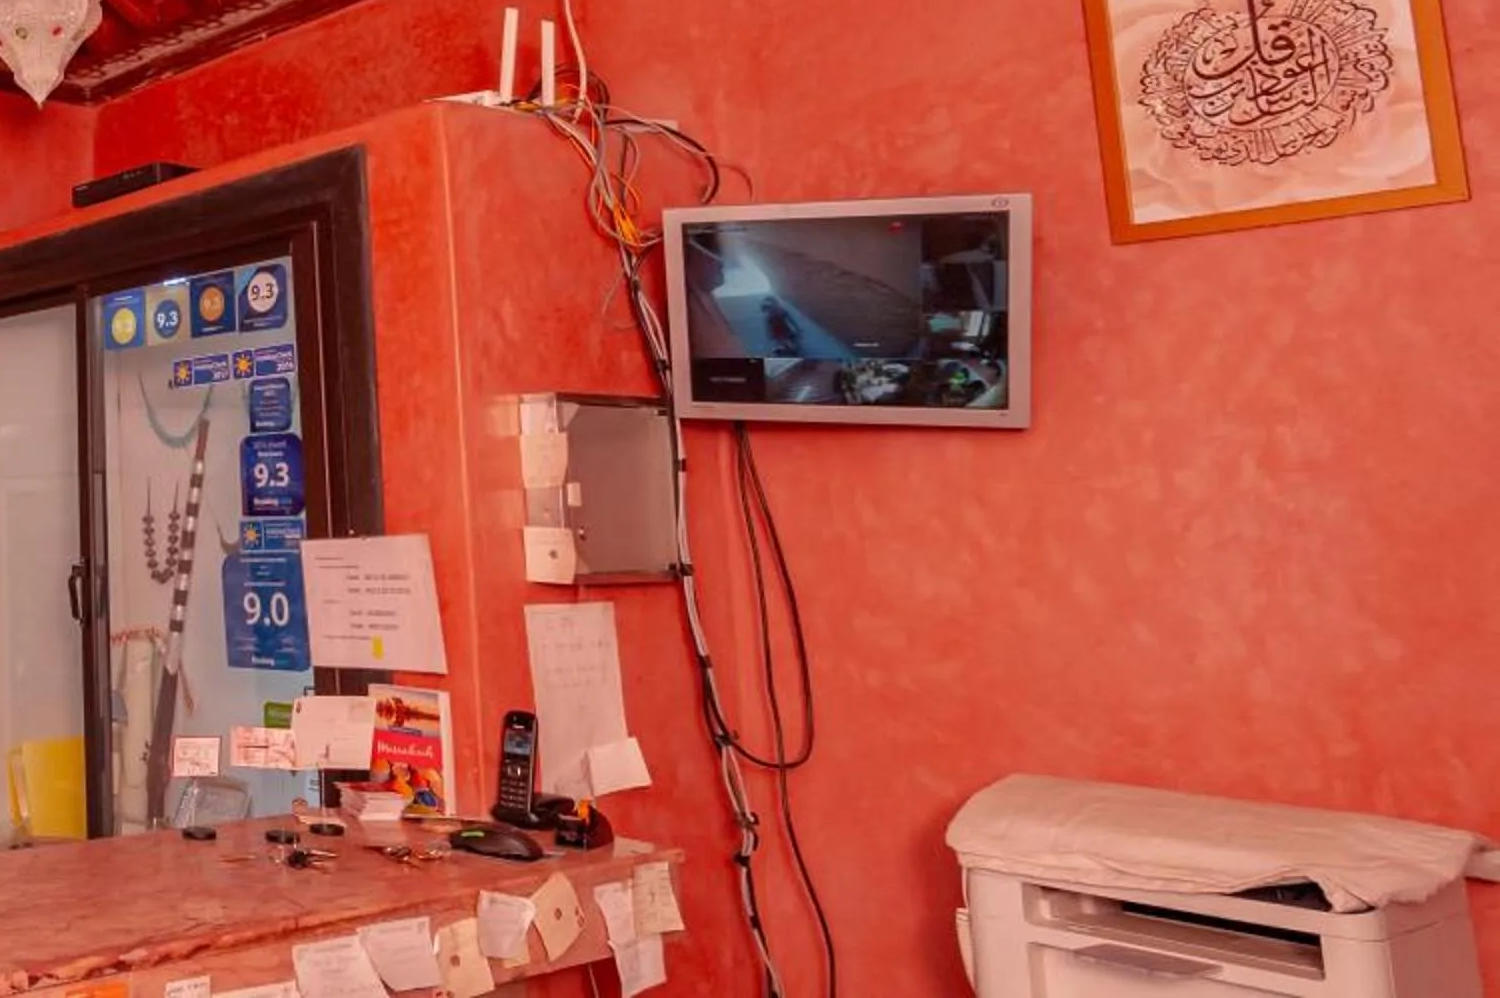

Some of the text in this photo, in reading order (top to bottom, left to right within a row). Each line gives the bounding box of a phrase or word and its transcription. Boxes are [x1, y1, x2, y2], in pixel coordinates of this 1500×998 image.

[251, 282, 275, 301] 9.3
[157, 311, 180, 329] 9.3
[254, 462, 289, 488] 9.3
[243, 591, 289, 627] 9.0
